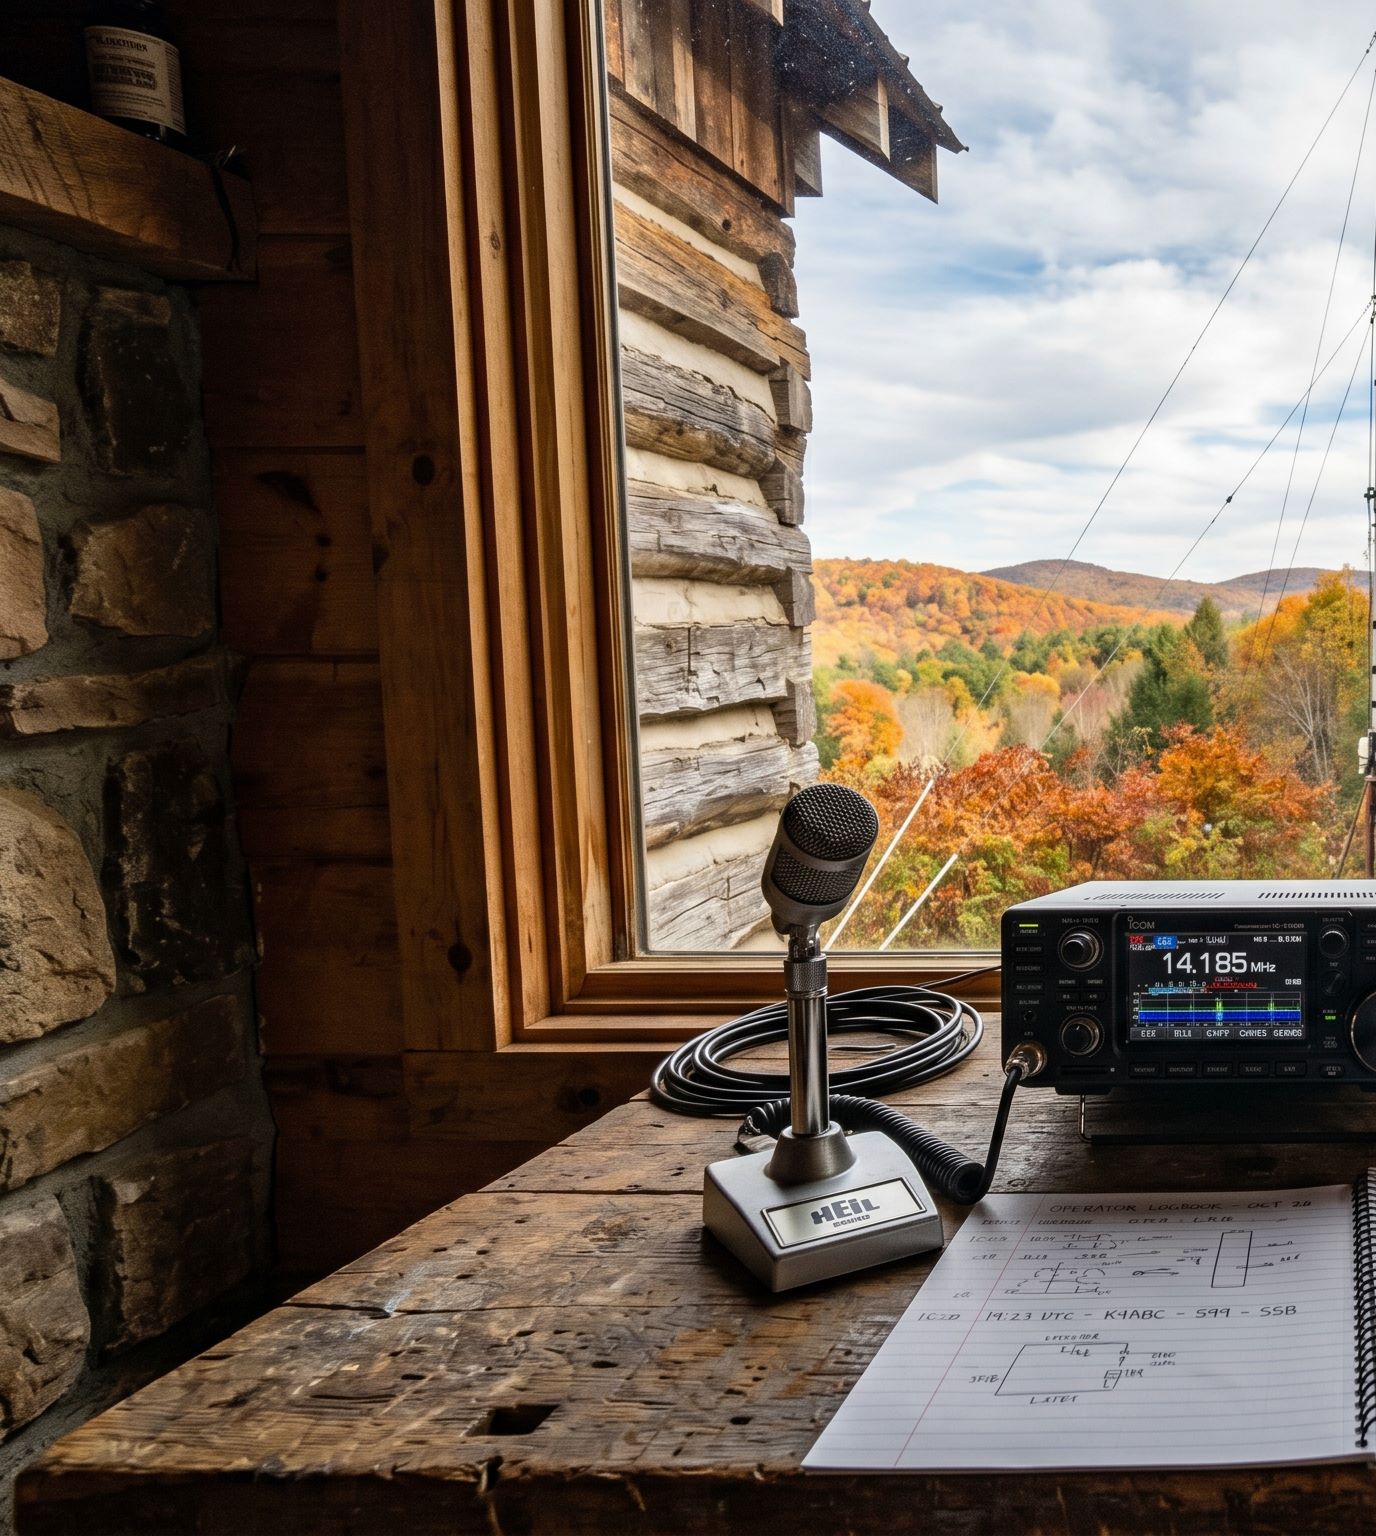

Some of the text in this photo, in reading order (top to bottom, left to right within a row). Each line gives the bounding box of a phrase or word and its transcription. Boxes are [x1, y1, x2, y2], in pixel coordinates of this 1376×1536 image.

[1162, 952, 1276, 974] 14.185 MHz
[1049, 1204, 1137, 1213] OPERATOR
[1148, 1202, 1223, 1211] LOGBOOK
[1104, 1309, 1166, 1320] K4ABC
[1259, 1305, 1298, 1317] SSB
